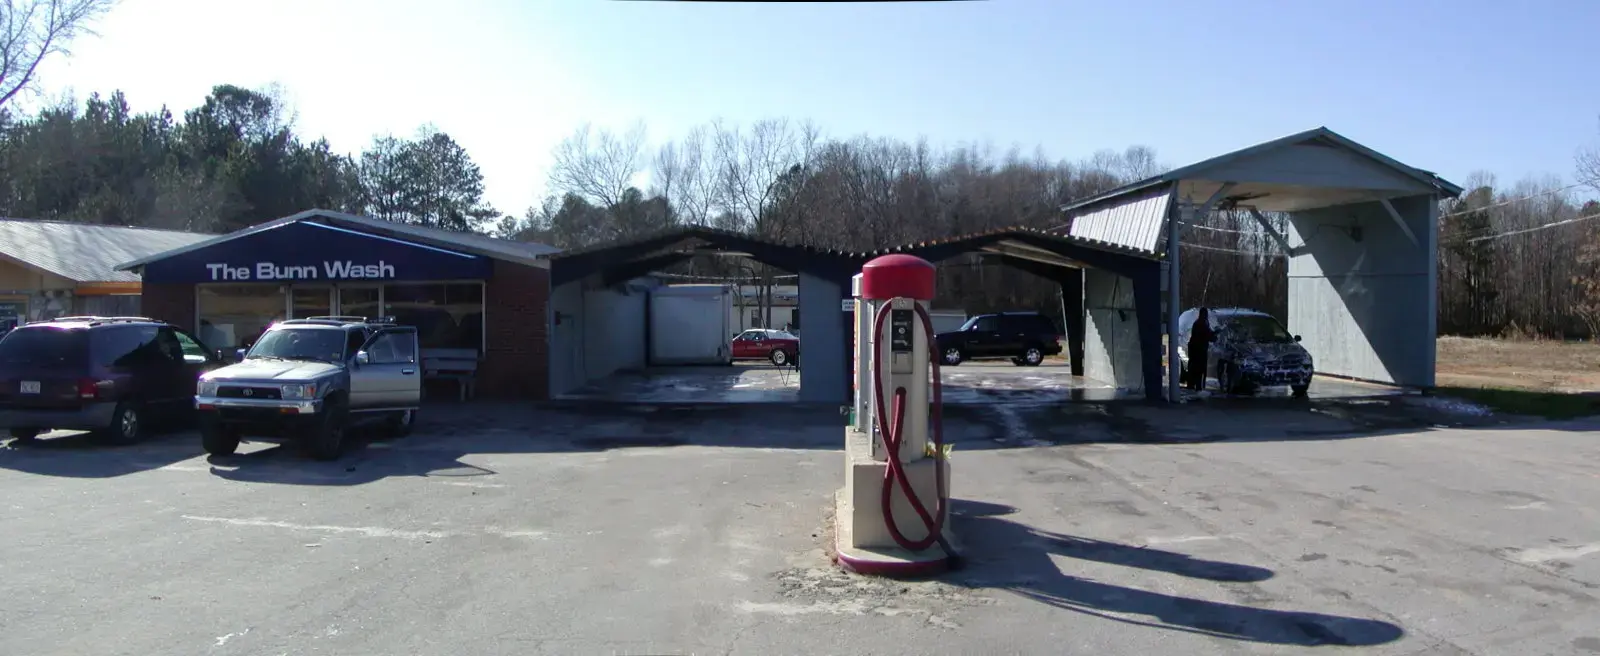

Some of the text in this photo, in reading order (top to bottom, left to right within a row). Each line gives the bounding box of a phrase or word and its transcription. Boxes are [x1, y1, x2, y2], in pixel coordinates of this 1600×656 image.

[206, 260, 395, 280] The Bunn Wash
